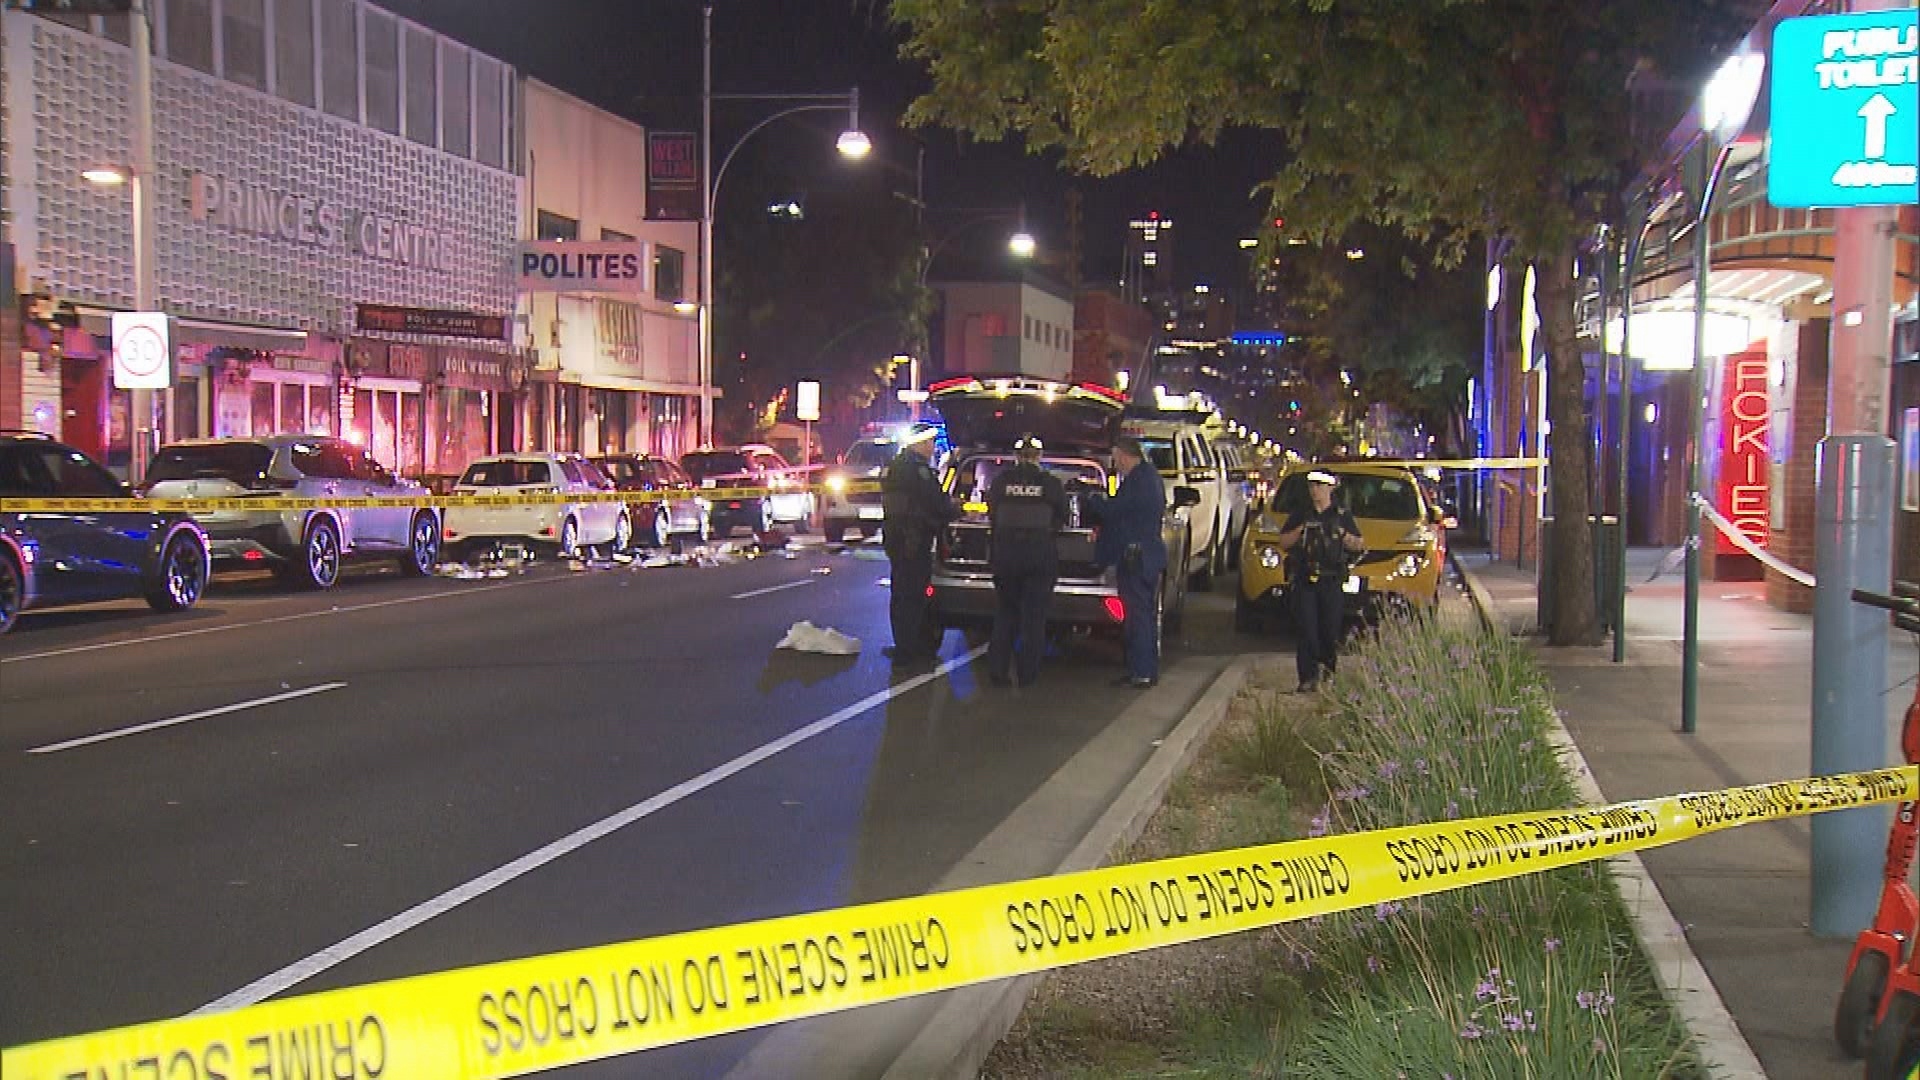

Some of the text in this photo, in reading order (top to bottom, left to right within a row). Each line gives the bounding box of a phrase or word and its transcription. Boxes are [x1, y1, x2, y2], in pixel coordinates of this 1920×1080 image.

[653, 139, 692, 160] WEST
[192, 172, 455, 274] PRINCES CENTRE
[523, 253, 638, 278] POLITES
[127, 339, 157, 361] 30
[1006, 484, 1042, 497] POLICE
[1386, 806, 1657, 882] CRIME SCENE DO NOT CROSS
[1006, 851, 1350, 953] CRIME SCENE DO NOT CROSS
[478, 917, 950, 1056] CRIME SCENE DO NOT CROSS
[246, 1014, 388, 1080] CRIME
